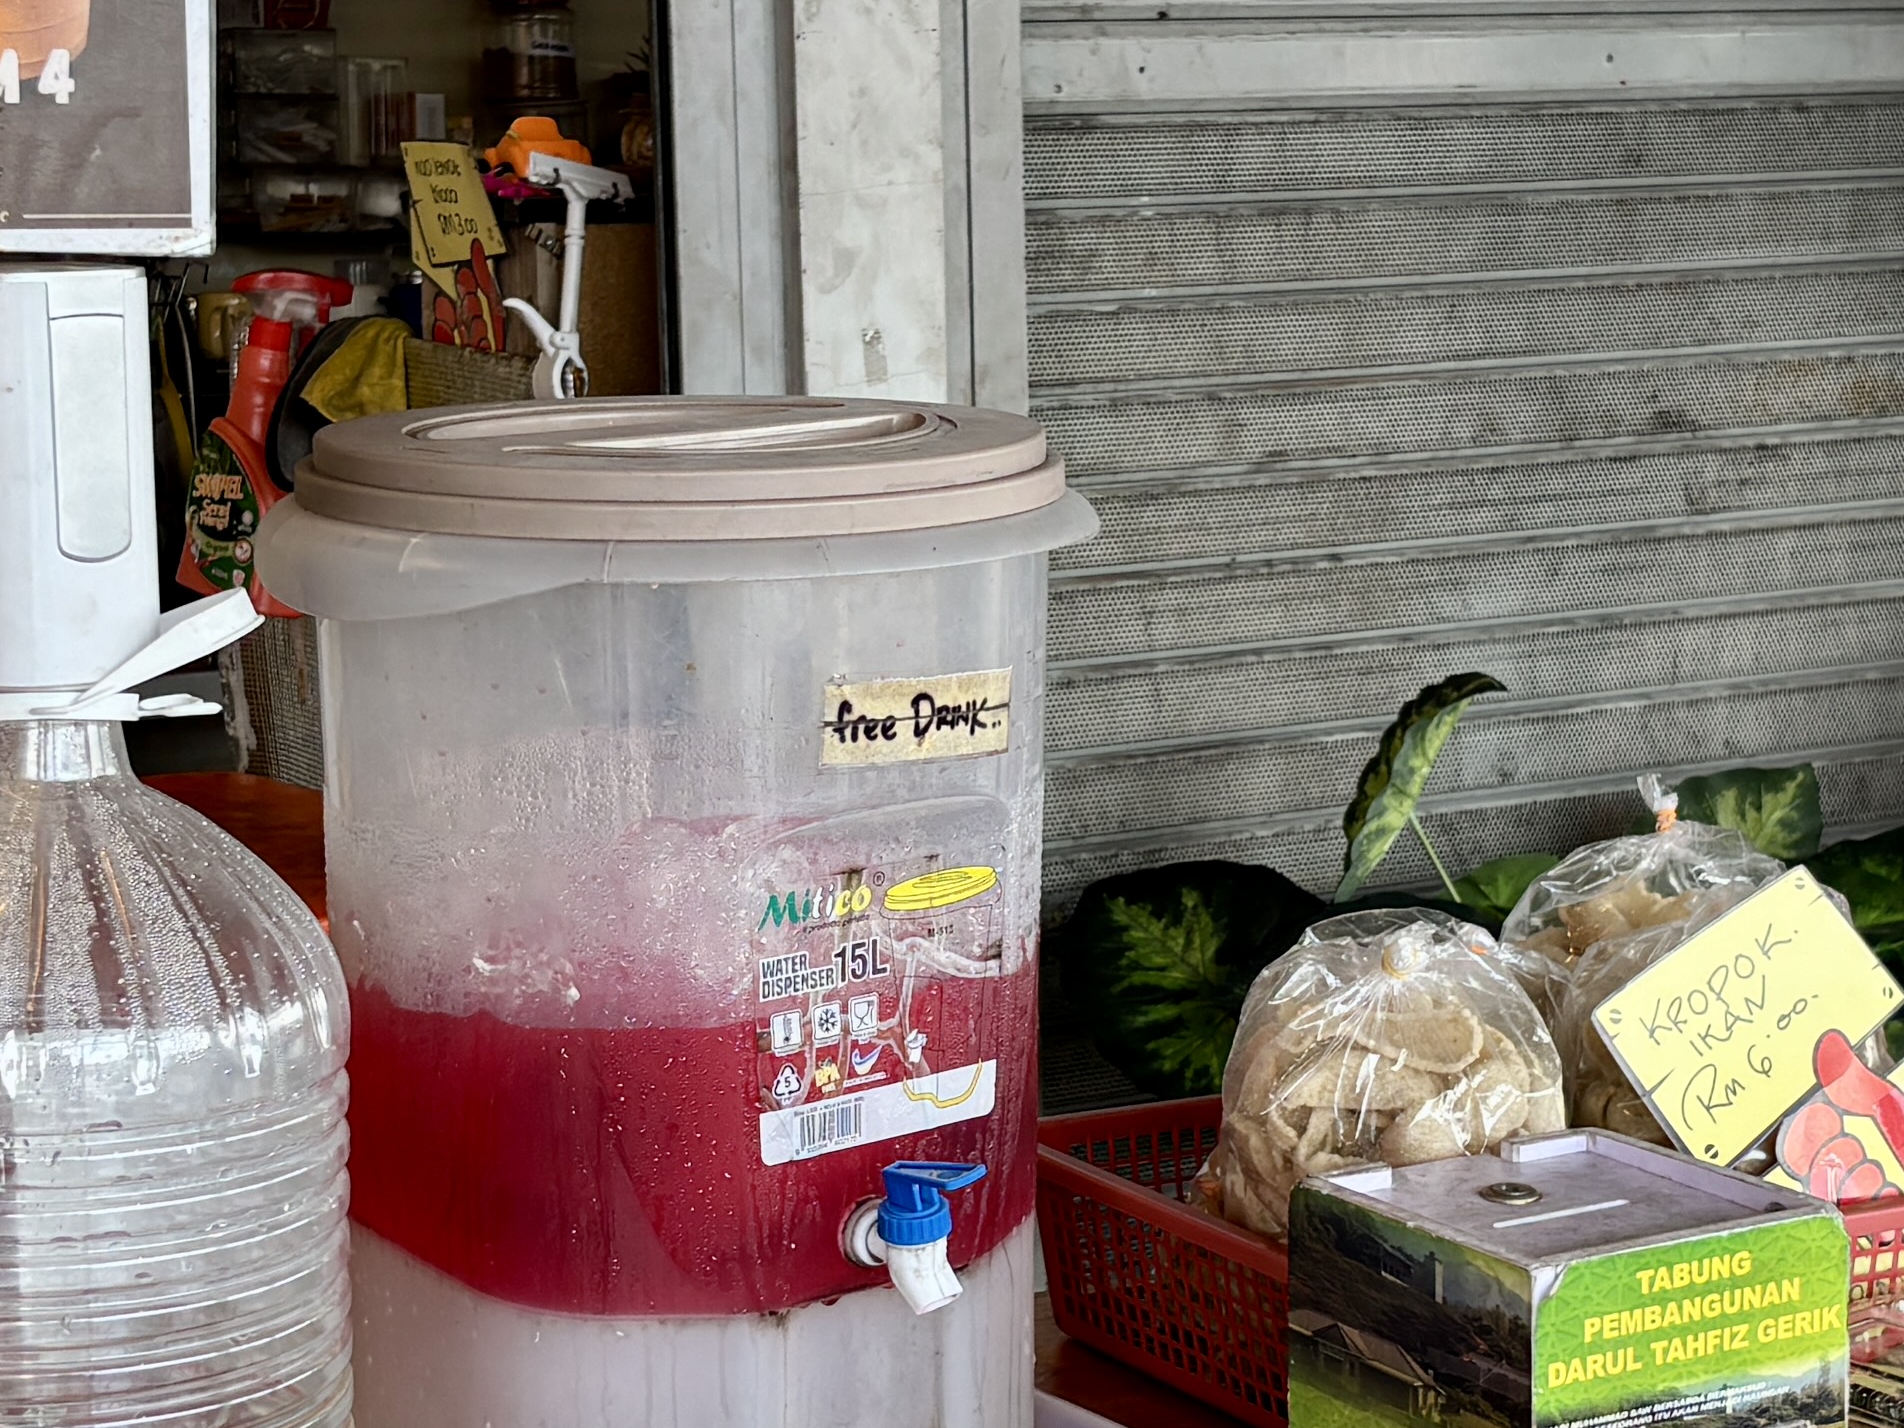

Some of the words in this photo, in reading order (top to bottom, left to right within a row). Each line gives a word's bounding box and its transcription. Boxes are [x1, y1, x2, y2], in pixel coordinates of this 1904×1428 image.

[37, 47, 76, 105] 4
[758, 884, 872, 933] Mitico
[761, 954, 807, 979] WATER
[762, 968, 835, 999] DISPENSER
[833, 938, 889, 983] 15L
[1690, 975, 1767, 1056] IKAN
[1636, 1250, 1753, 1296] TABUNG
[1583, 1277, 1802, 1343] PEMBANGUNAN
[1547, 1347, 1642, 1389] DARUL
[1650, 1325, 1751, 1368] TAHFIZ
[1757, 1304, 1842, 1346] GERIK
